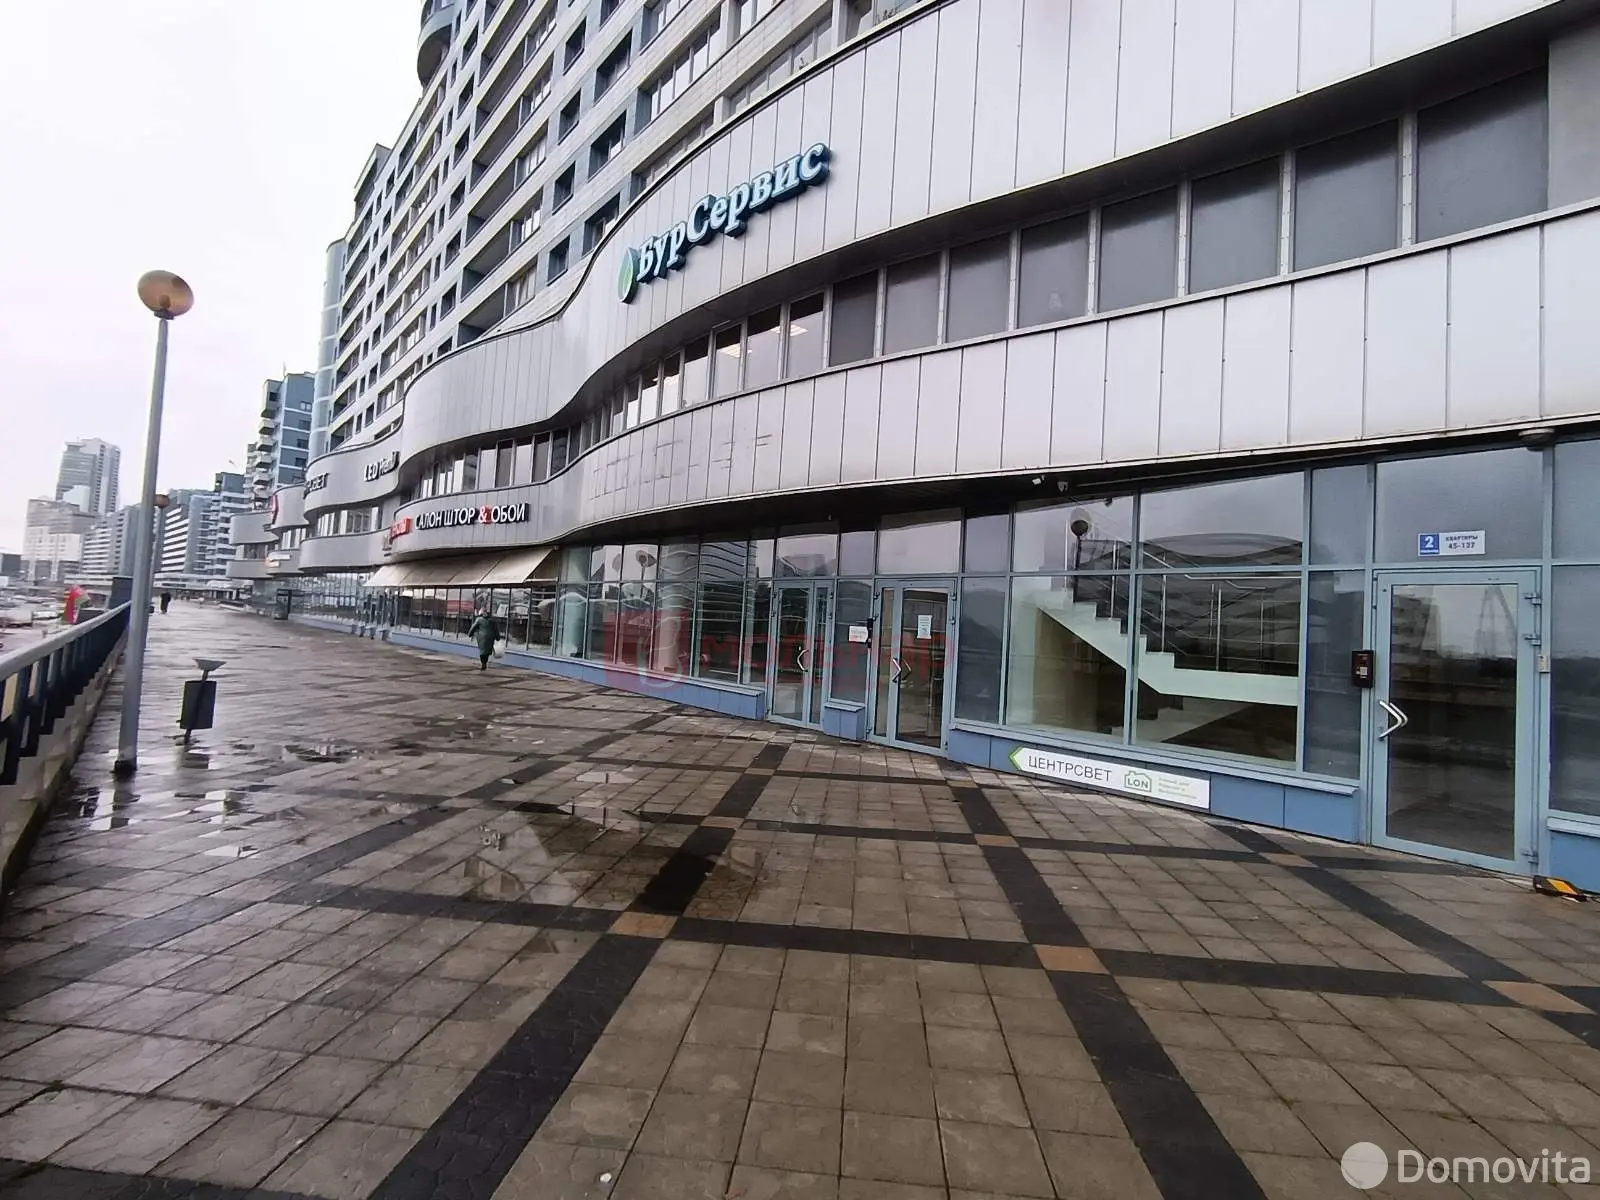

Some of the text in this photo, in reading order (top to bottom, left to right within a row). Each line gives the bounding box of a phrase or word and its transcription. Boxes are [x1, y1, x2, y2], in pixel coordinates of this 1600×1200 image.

[637, 142, 831, 283] БурСервис
[415, 502, 530, 530] САЛОН ШТОР & ОБОИ
[1425, 535, 1434, 548] 2
[1028, 755, 1113, 782] ЦЕНТРСВЕТ
[1127, 779, 1149, 790] LON
